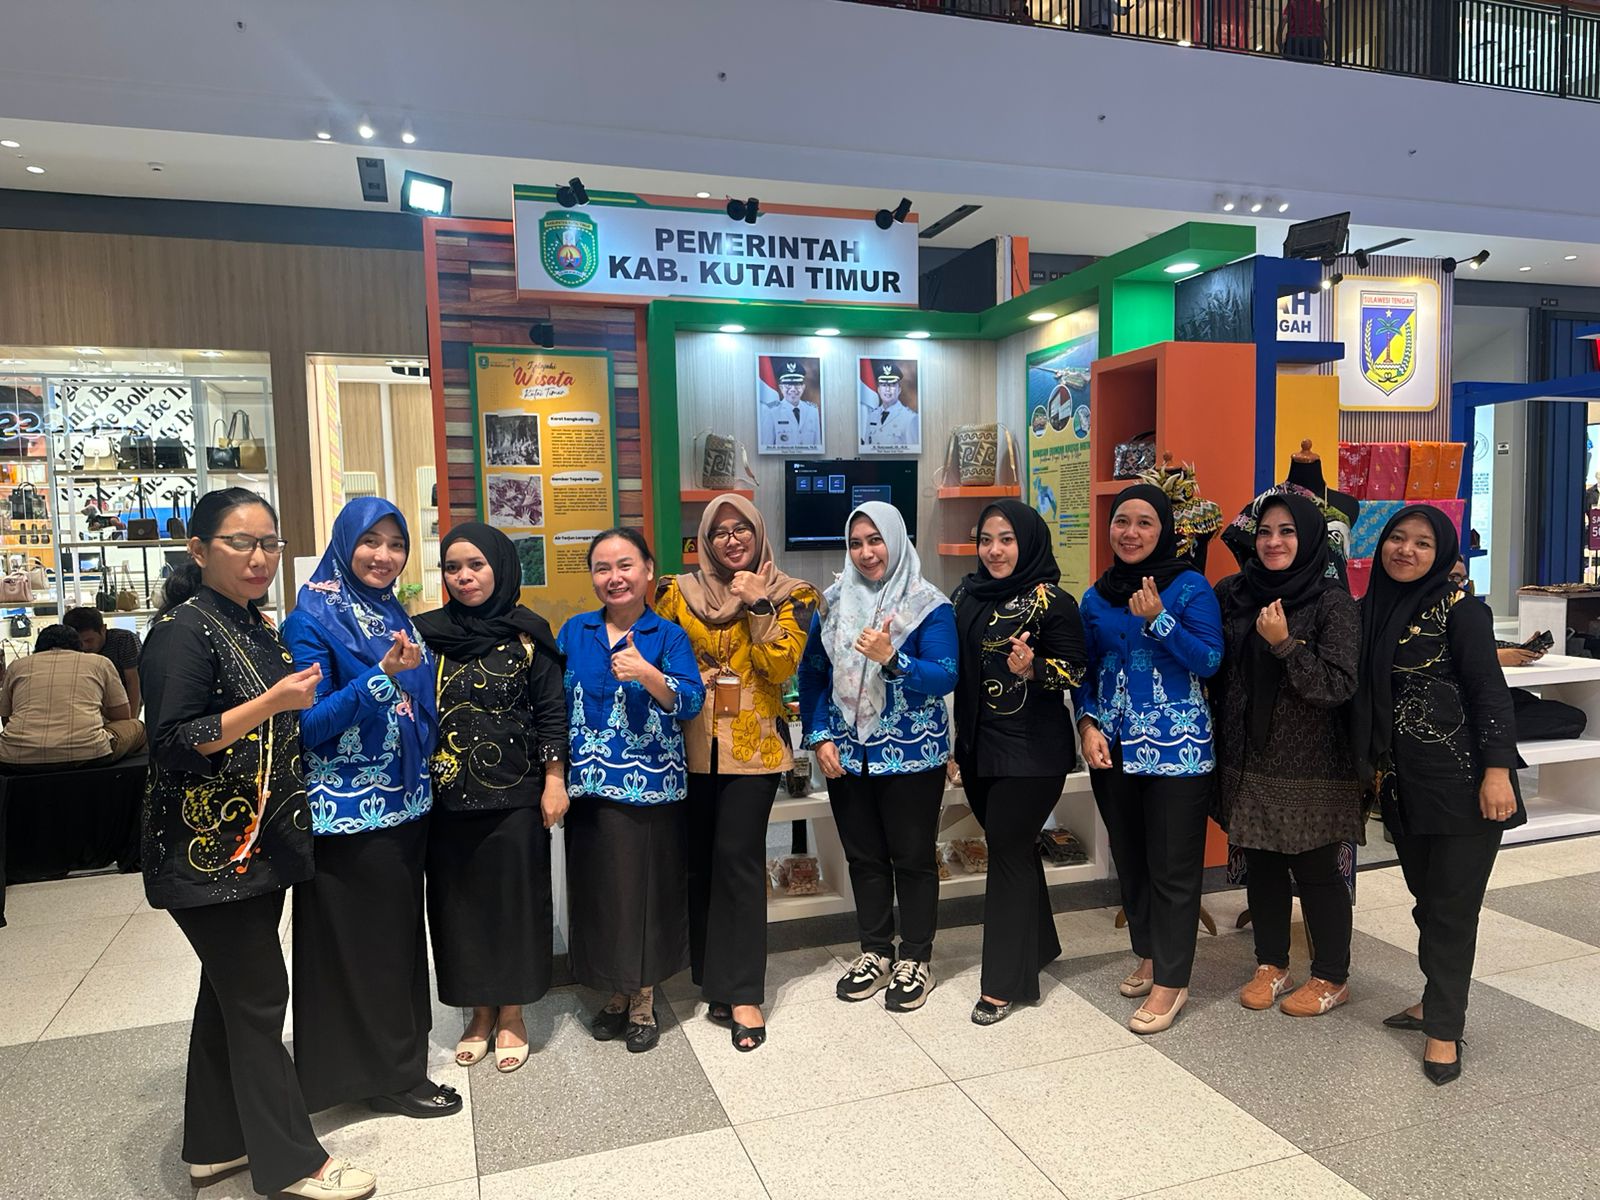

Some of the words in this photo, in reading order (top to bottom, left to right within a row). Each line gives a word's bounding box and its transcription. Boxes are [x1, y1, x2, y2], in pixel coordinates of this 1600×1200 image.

[655, 228, 861, 263] PEMERINTAH
[608, 255, 688, 283] KAB.
[700, 260, 794, 290] KUTAI
[805, 266, 901, 294] TIMUR
[1363, 295, 1391, 304] SULAWESI
[1391, 296, 1414, 305] TENGAH
[513, 366, 576, 388] Wisata
[144, 398, 171, 421] Be
